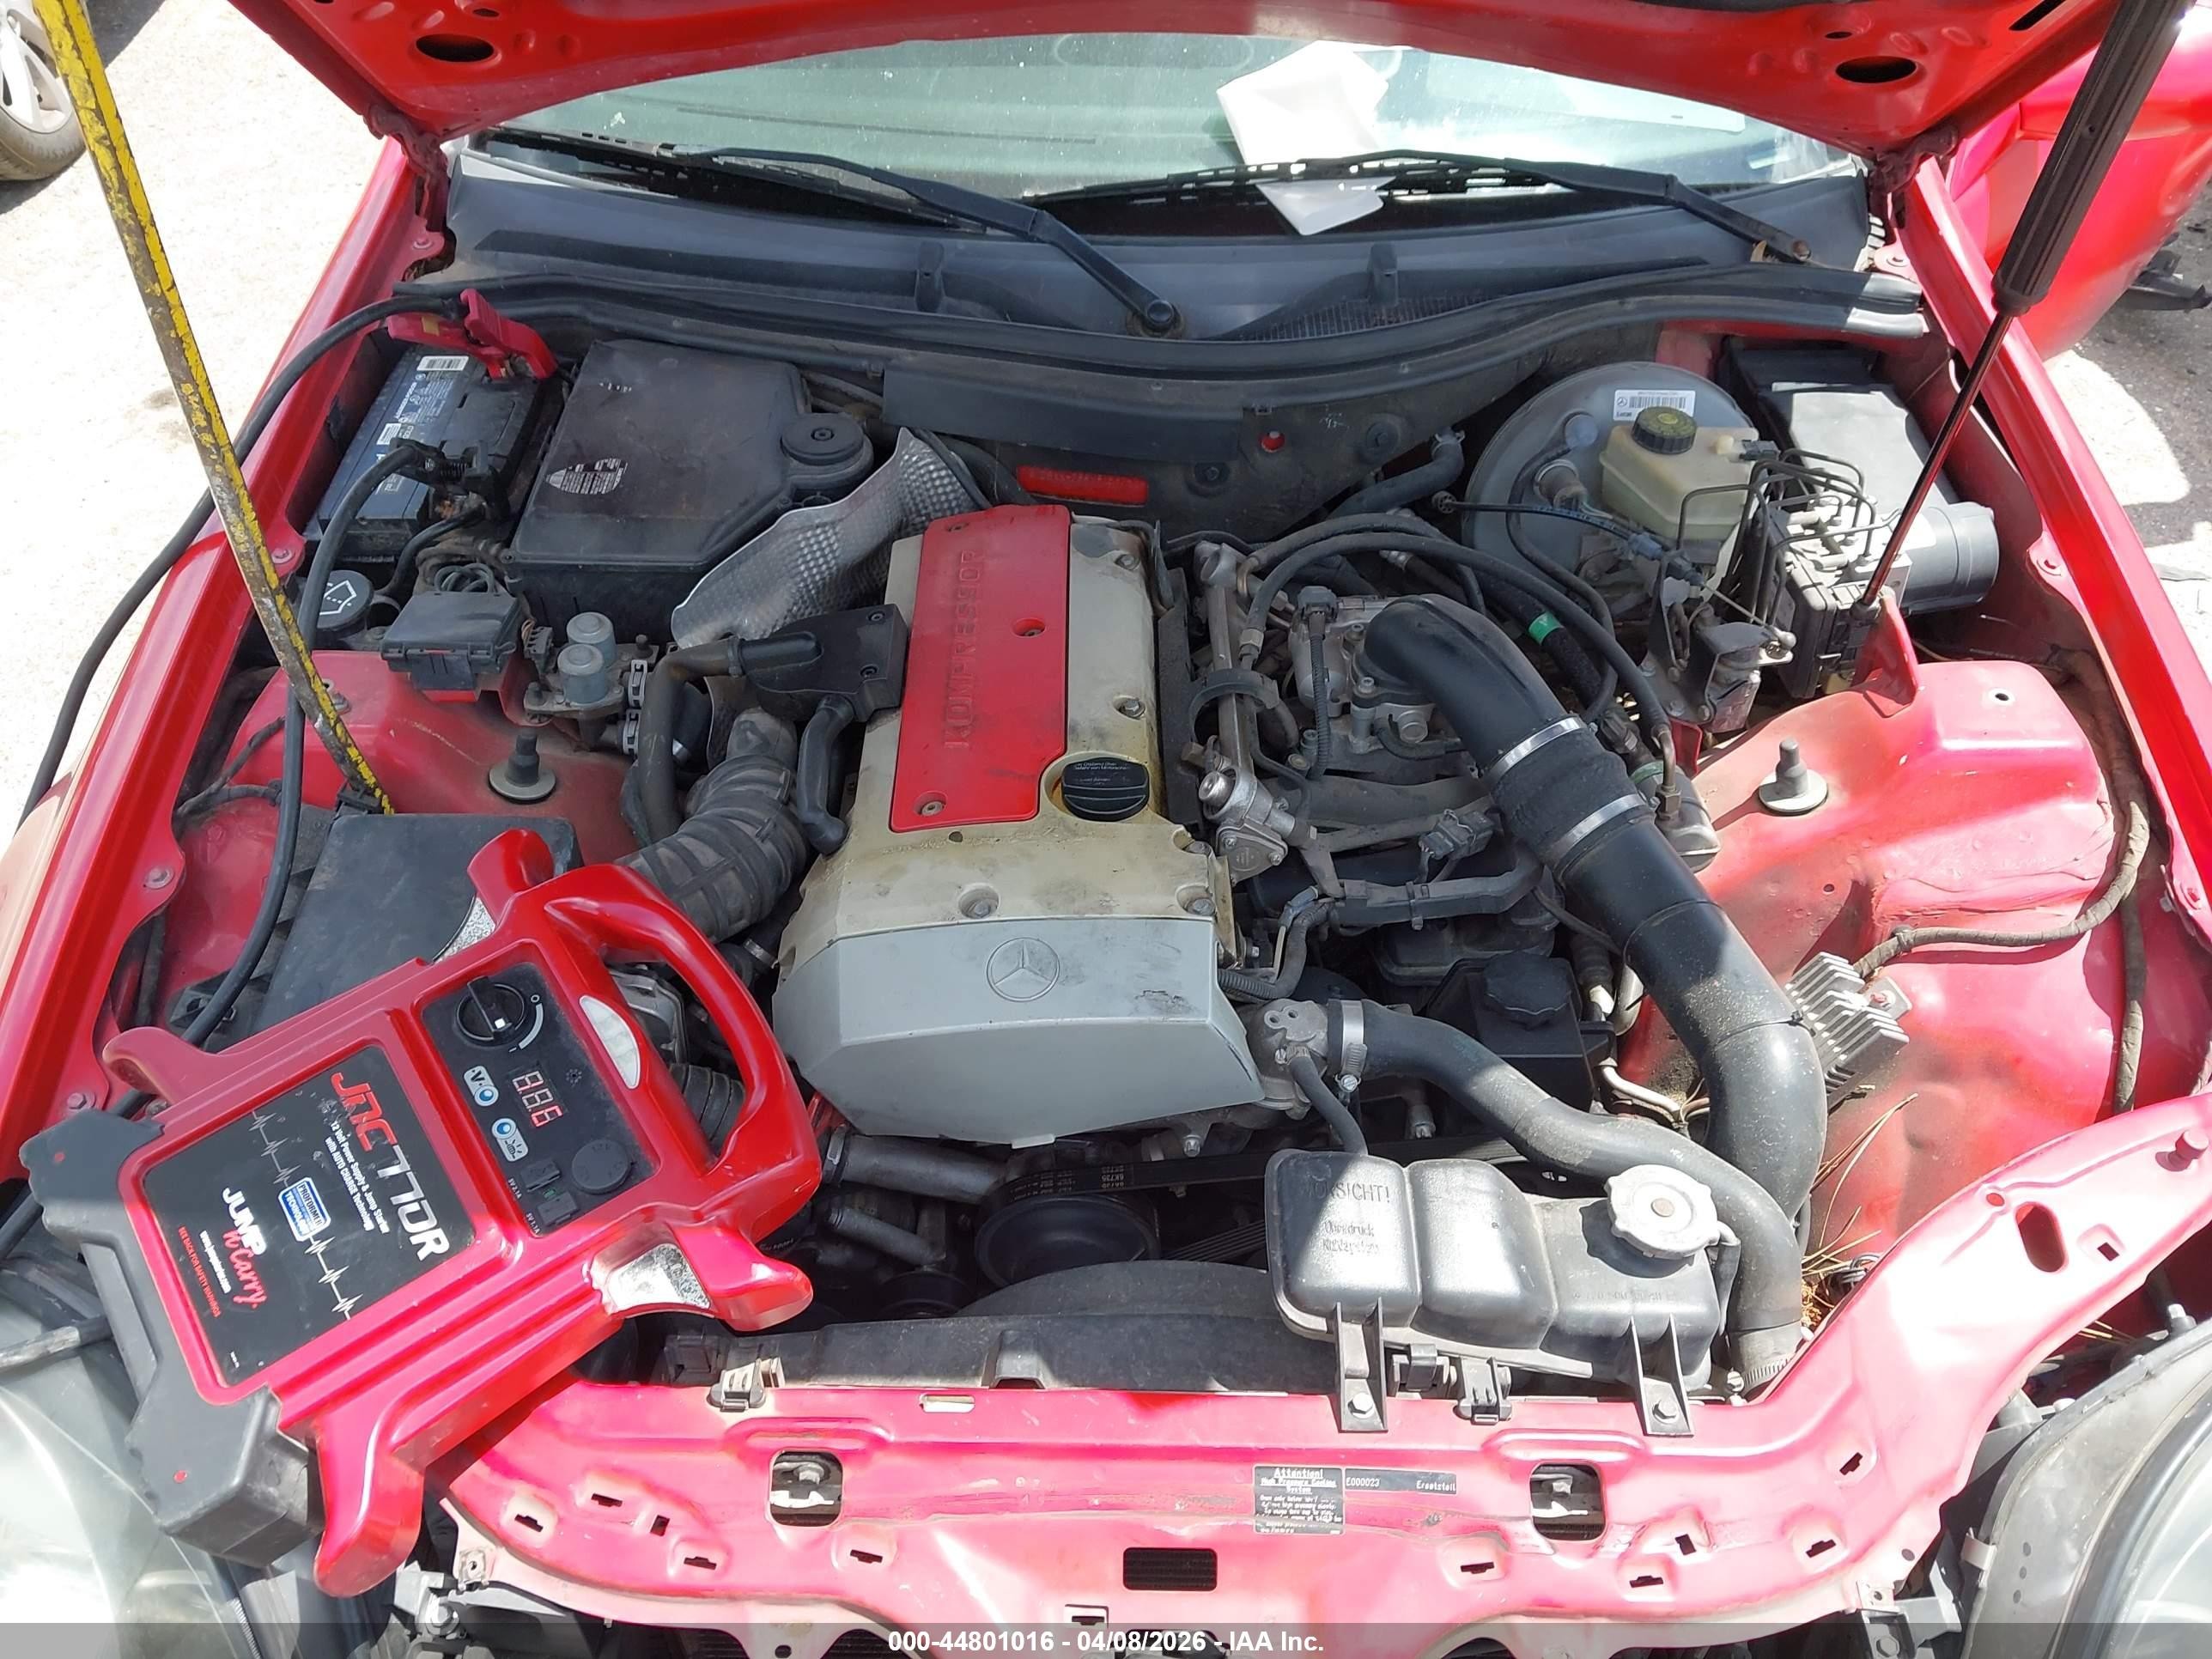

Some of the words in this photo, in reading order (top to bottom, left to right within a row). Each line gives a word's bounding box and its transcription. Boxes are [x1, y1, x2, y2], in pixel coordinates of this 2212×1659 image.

[324, 1136, 337, 1152] with
[331, 1151, 345, 1169] AUTO
[339, 1167, 358, 1194] CHARGE
[351, 1193, 374, 1231] Technology
[333, 1129, 346, 1144] Volt
[340, 1141, 355, 1164] Power
[349, 1162, 366, 1186] Supply
[362, 1190, 378, 1211] Jump
[222, 1188, 266, 1255] JUMP
[1273, 1468, 1324, 1480] Attention!
